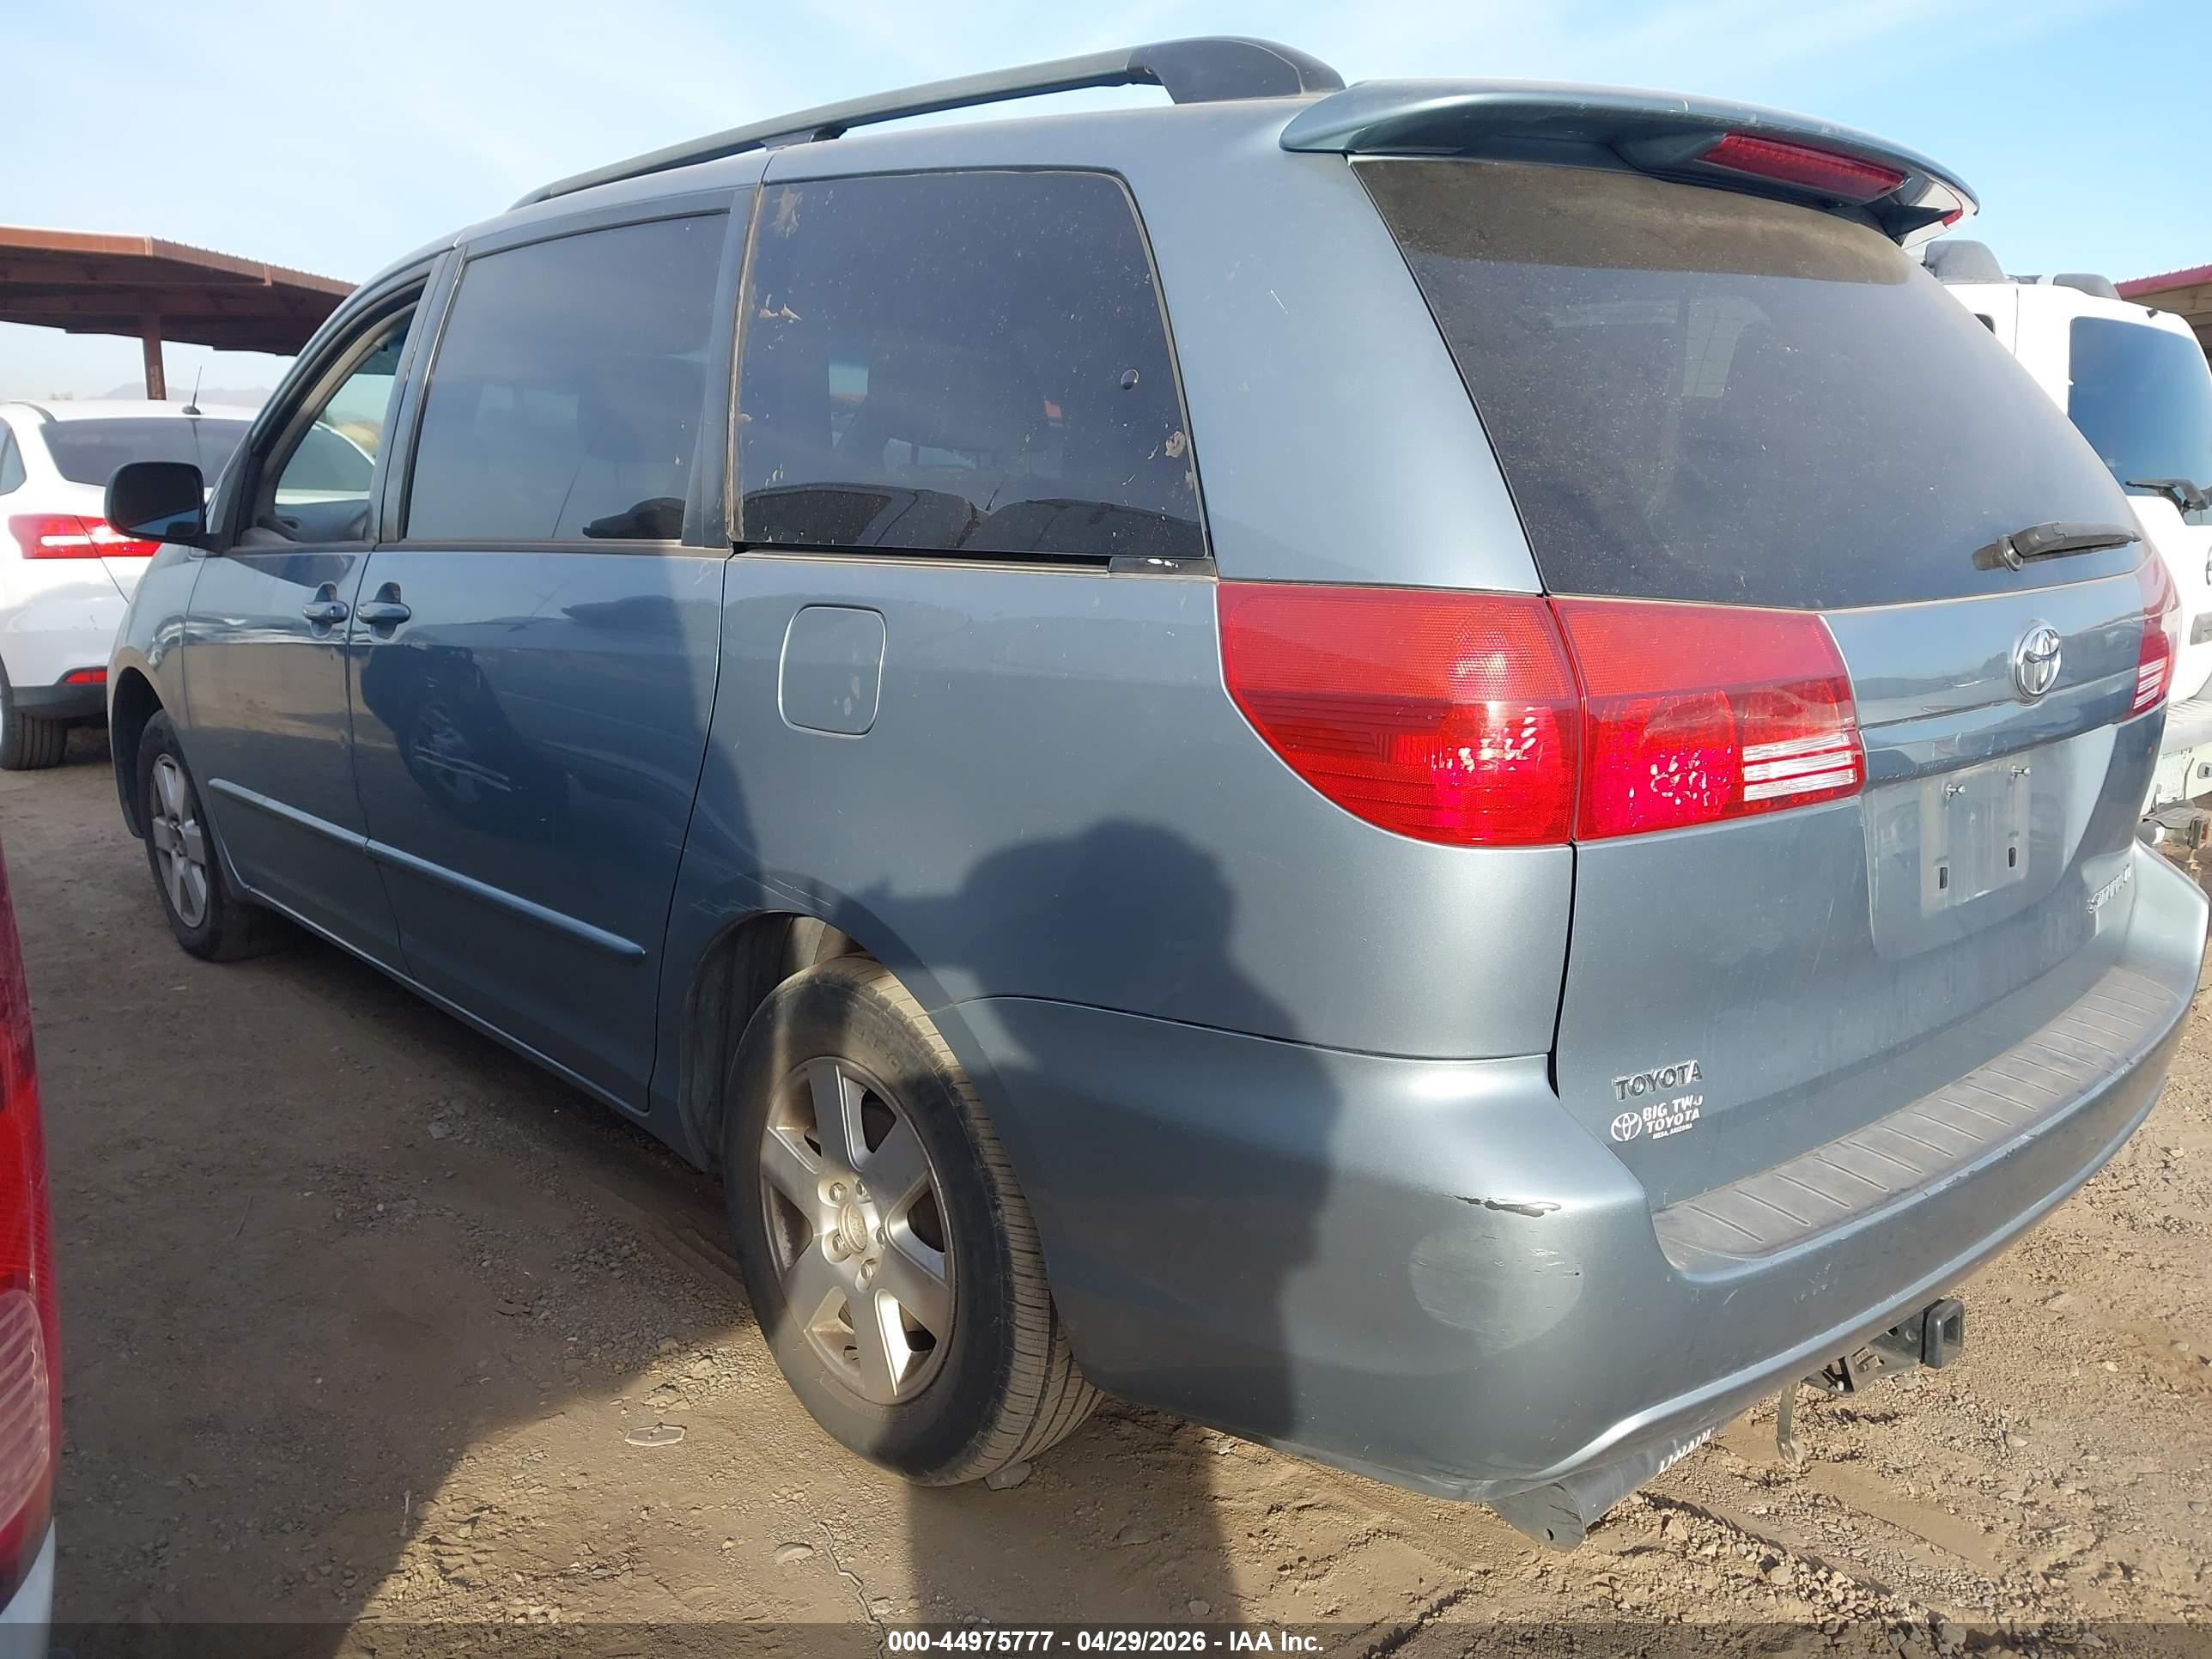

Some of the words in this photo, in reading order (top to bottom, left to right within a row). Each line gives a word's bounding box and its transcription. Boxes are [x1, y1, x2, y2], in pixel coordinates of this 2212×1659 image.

[1611, 1059, 1704, 1102] TOYOTA
[1642, 1102, 1668, 1121] BIG
[1646, 1107, 1700, 1134] TOYOTA
